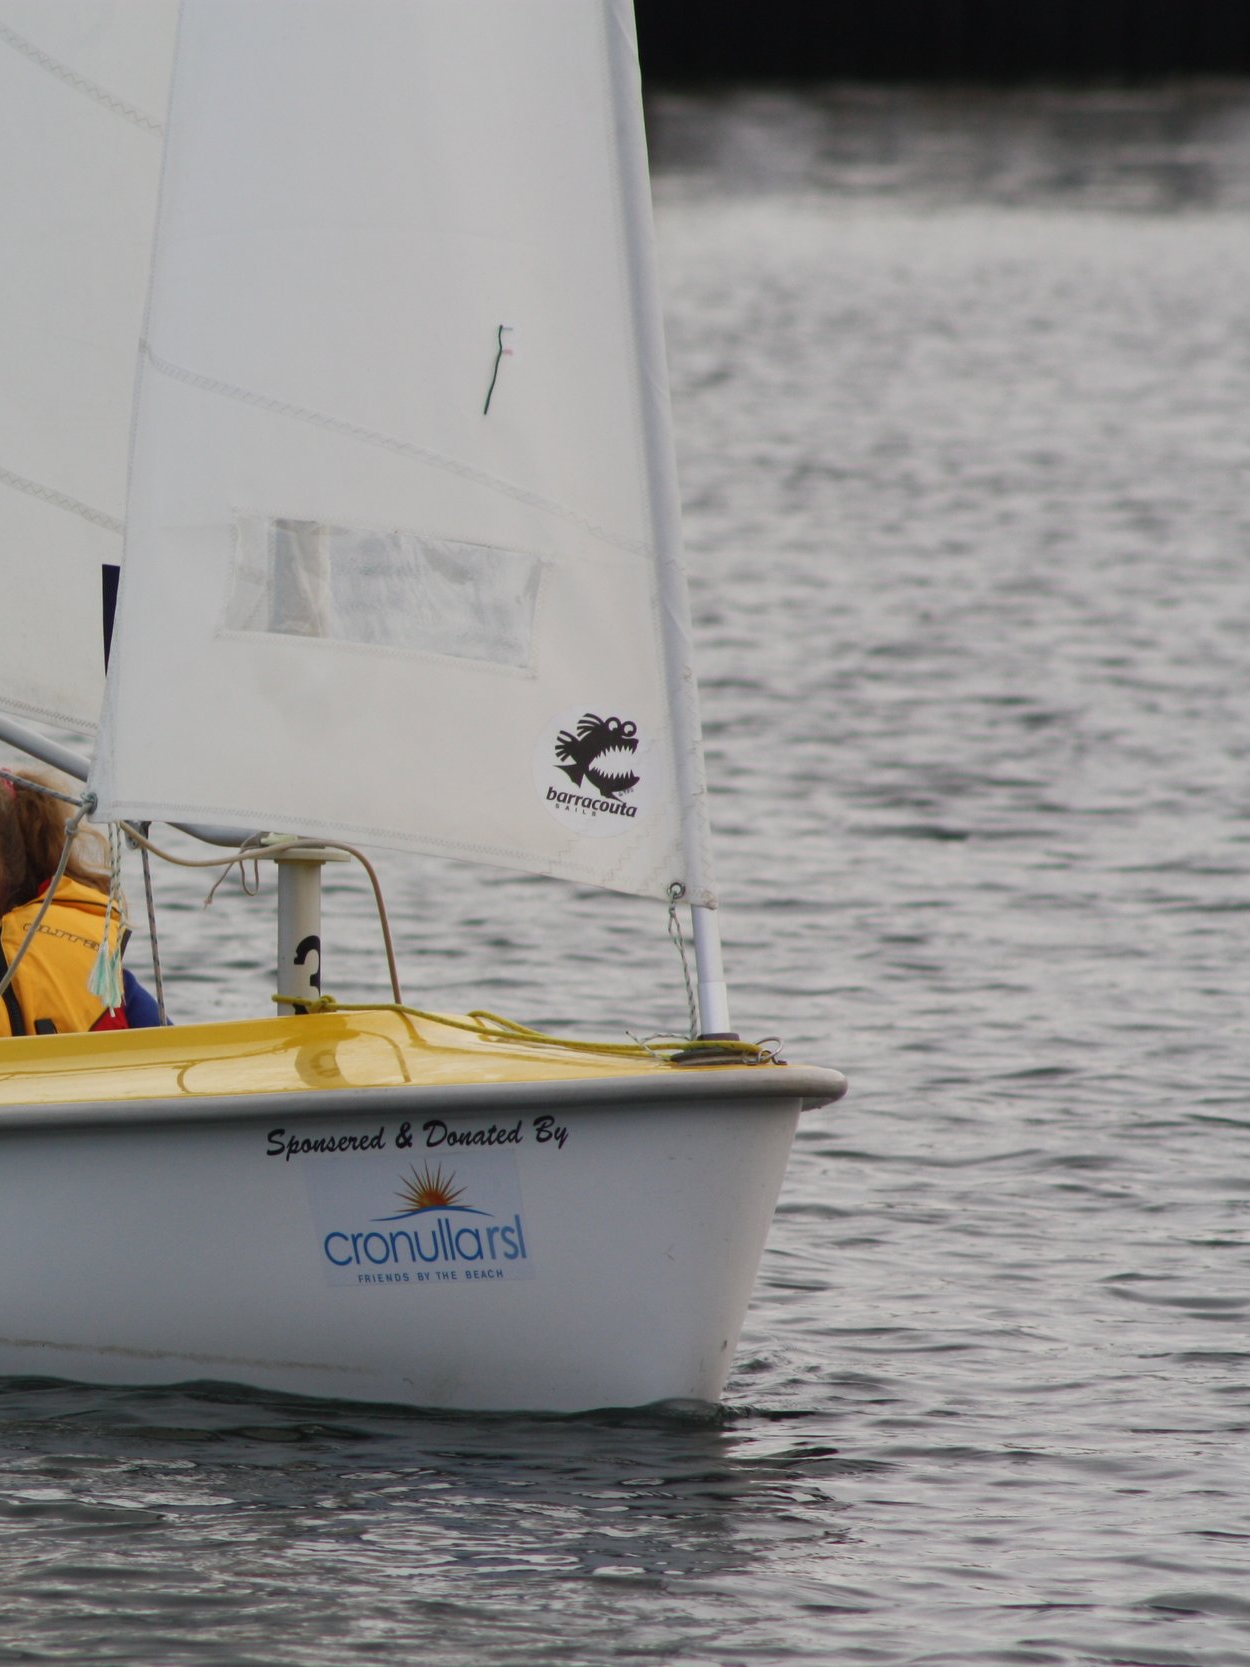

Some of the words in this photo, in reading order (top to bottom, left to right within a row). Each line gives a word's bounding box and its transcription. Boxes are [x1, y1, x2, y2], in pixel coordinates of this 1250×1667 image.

[546, 786, 638, 818] barracouta
[266, 1127, 387, 1162] Sponsered
[395, 1121, 414, 1150] &
[422, 1118, 524, 1149] Donated
[533, 1114, 570, 1150] By
[357, 1272, 410, 1284] FRIENDS
[417, 1271, 431, 1282] BY
[435, 1270, 458, 1281] THE
[465, 1268, 505, 1280] BEACH
